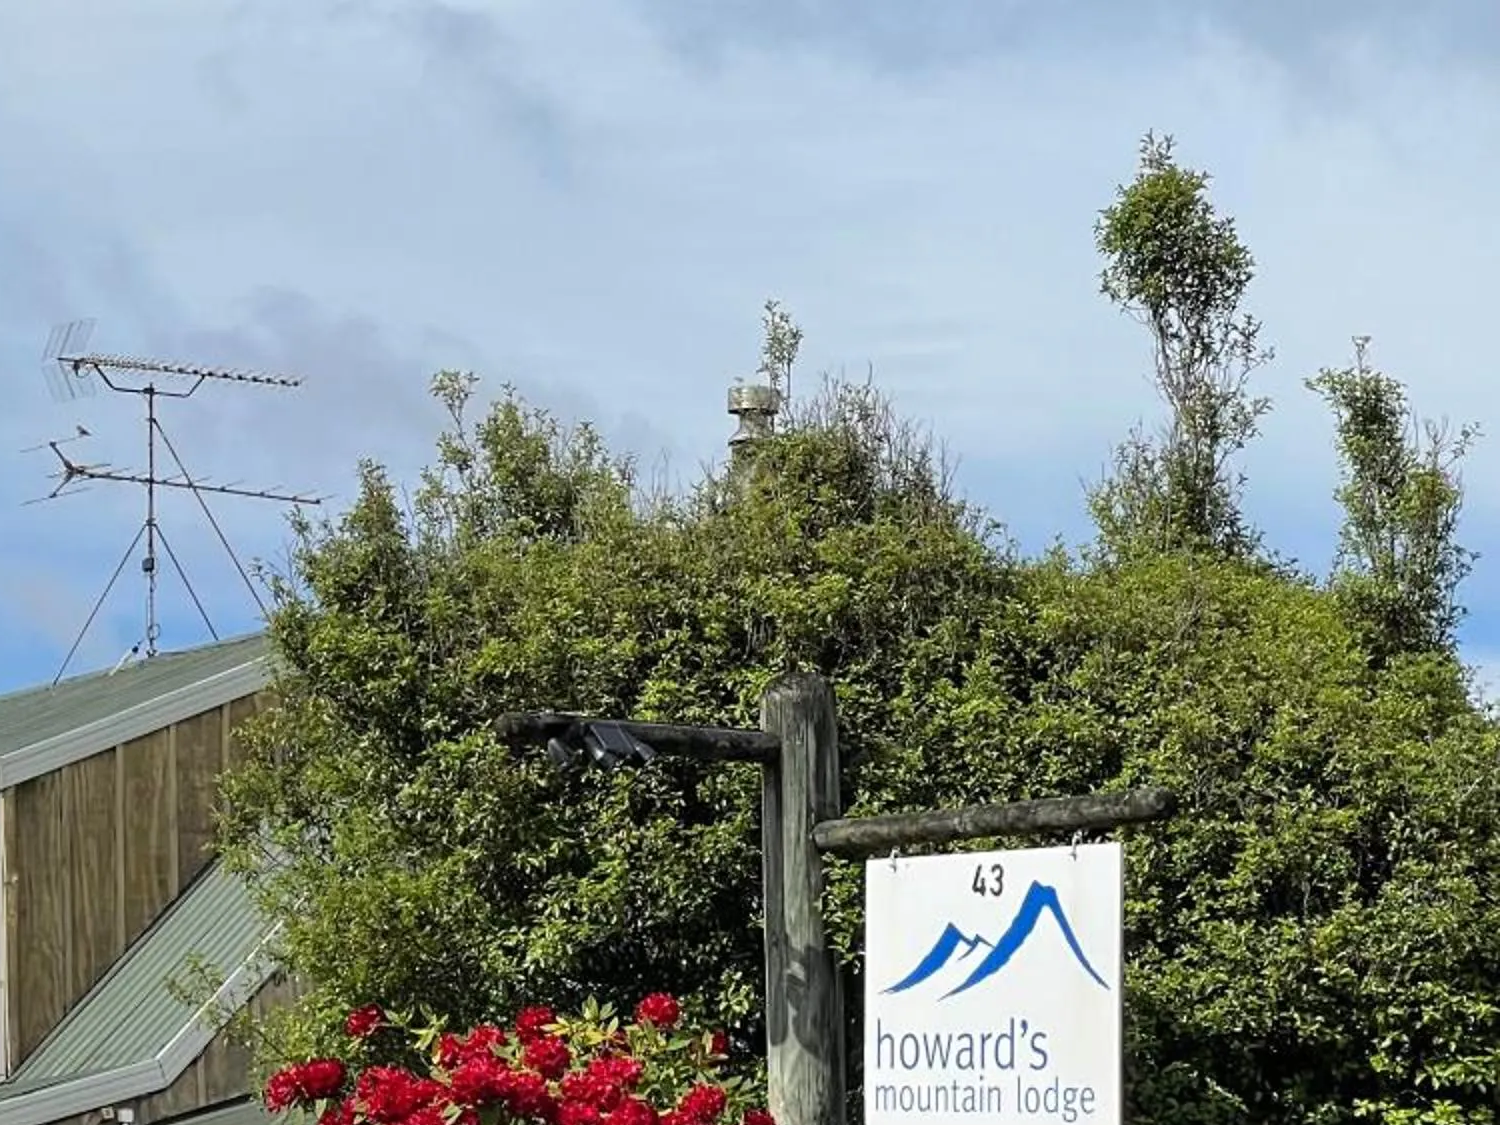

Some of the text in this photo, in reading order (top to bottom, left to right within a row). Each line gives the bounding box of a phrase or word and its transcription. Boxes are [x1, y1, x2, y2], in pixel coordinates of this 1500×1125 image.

[972, 864, 1004, 897] 43
[877, 1017, 1049, 1070] howard's
[875, 1075, 1096, 1122] mountain lodge
